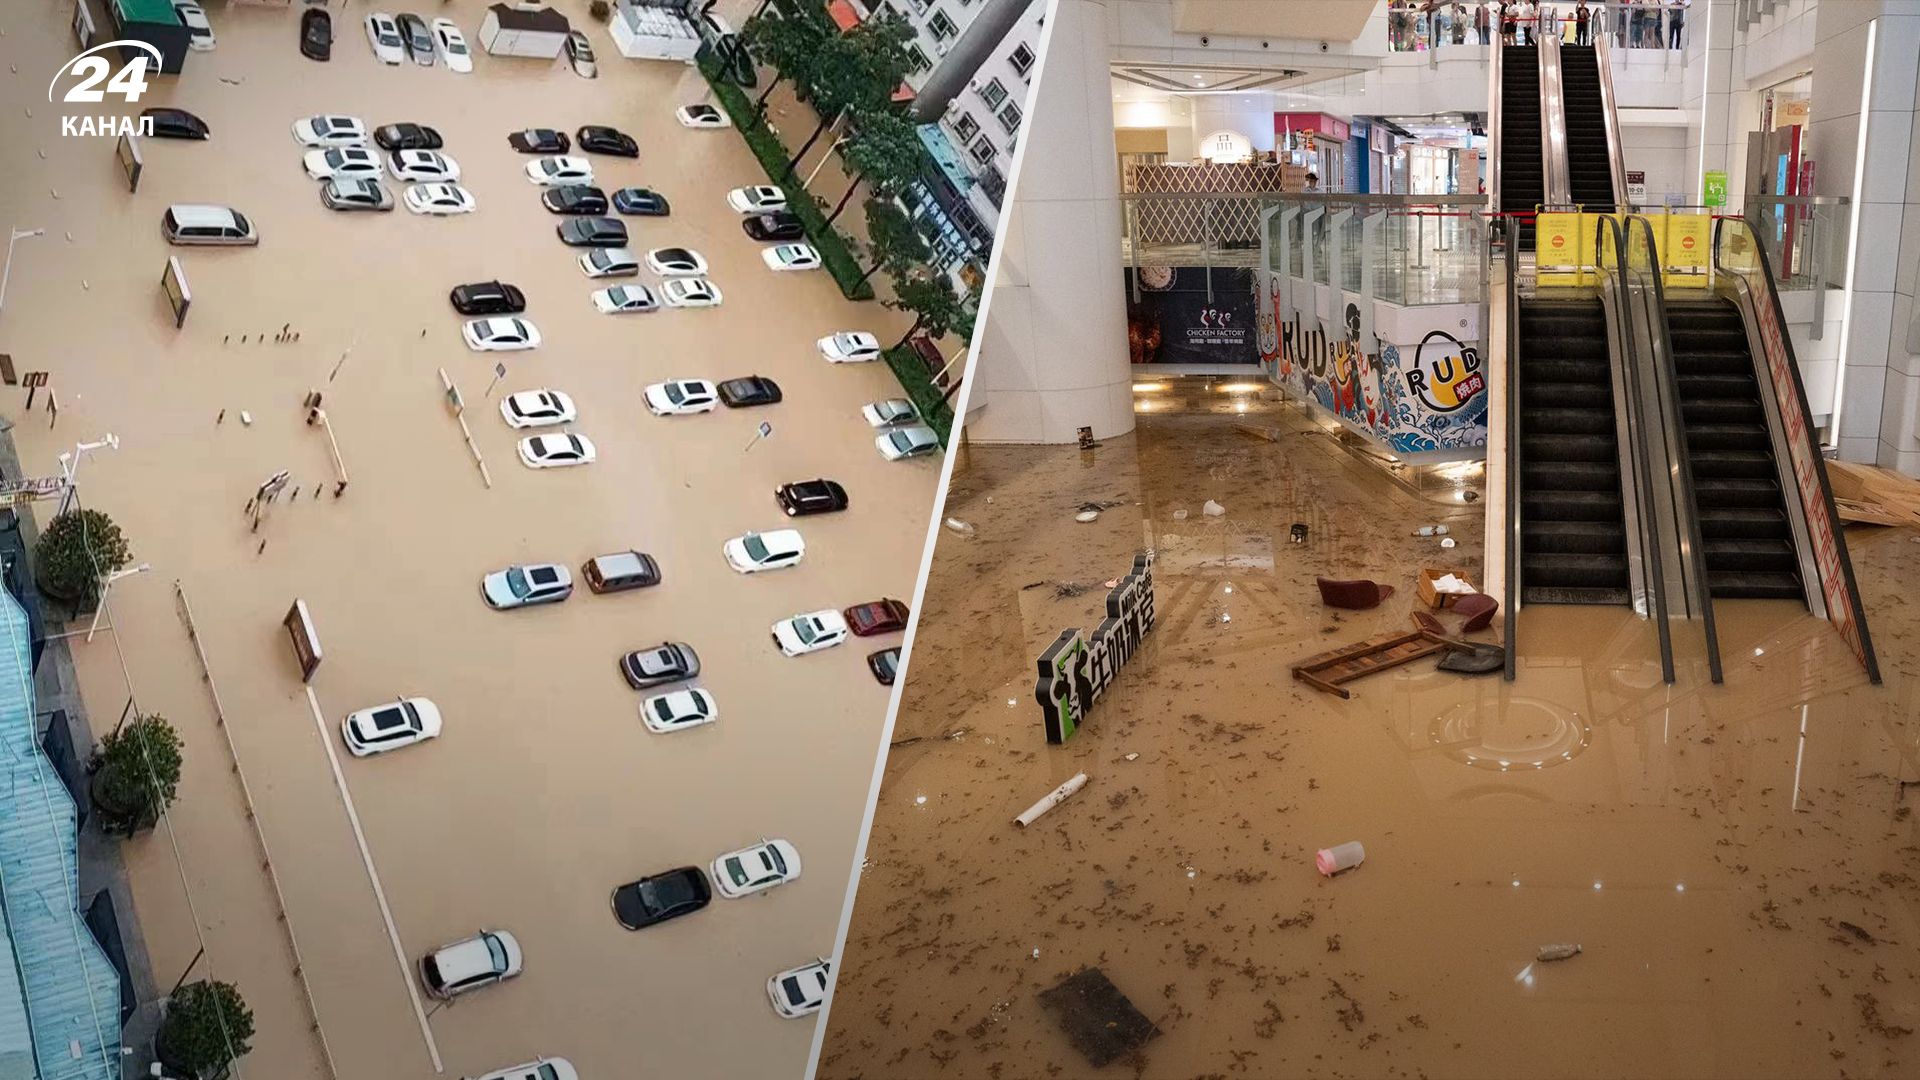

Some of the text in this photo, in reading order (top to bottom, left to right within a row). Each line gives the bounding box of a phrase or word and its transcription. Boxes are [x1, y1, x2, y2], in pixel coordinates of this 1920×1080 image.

[1186, 329, 1246, 337] CHICKEN FACTORY
[1405, 347, 1481, 396] RUD
[1121, 569, 1153, 615] Milk Café
